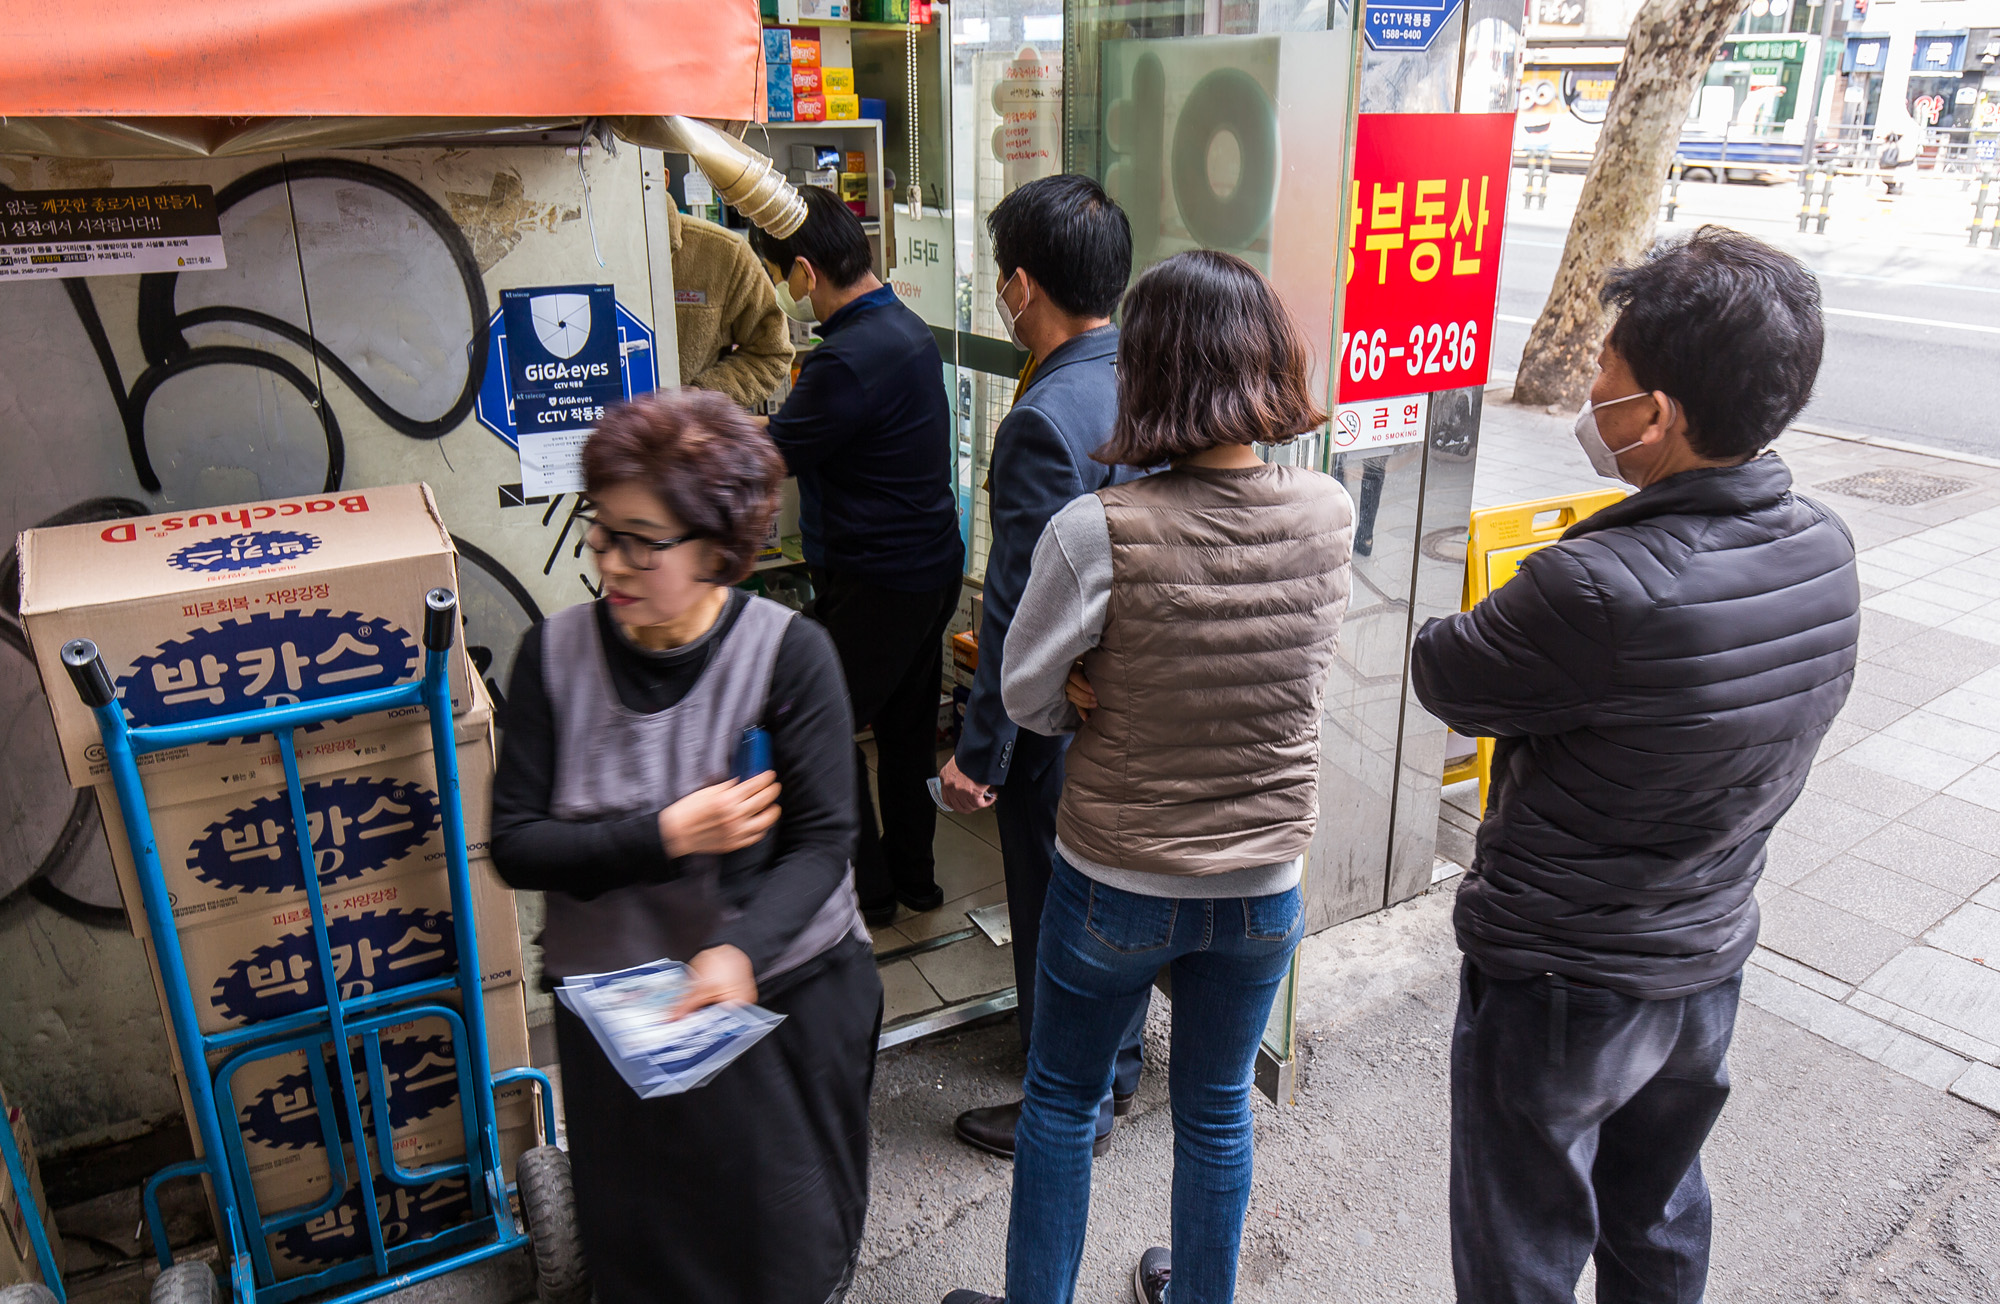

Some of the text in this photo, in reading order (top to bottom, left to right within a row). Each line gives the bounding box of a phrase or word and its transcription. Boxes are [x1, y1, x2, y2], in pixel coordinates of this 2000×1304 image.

[1382, 29, 1421, 40] 1588-6400
[6, 199, 38, 216] 없는
[41, 197, 88, 214] 깨끗한
[91, 194, 151, 213] 종로거리
[11, 219, 73, 237] 실천에서
[78, 215, 161, 234] 시작됩니다!!
[537, 406, 606, 424] CCTV 작동중
[1372, 429, 1418, 442] NO SMOKING
[186, 538, 305, 567] 박카스
[182, 584, 331, 618] 피로회복 자양강장
[151, 631, 386, 706] 박카스
[388, 704, 420, 719] 100mL
[314, 738, 357, 754] 자양강장
[343, 886, 398, 910] 자양강장
